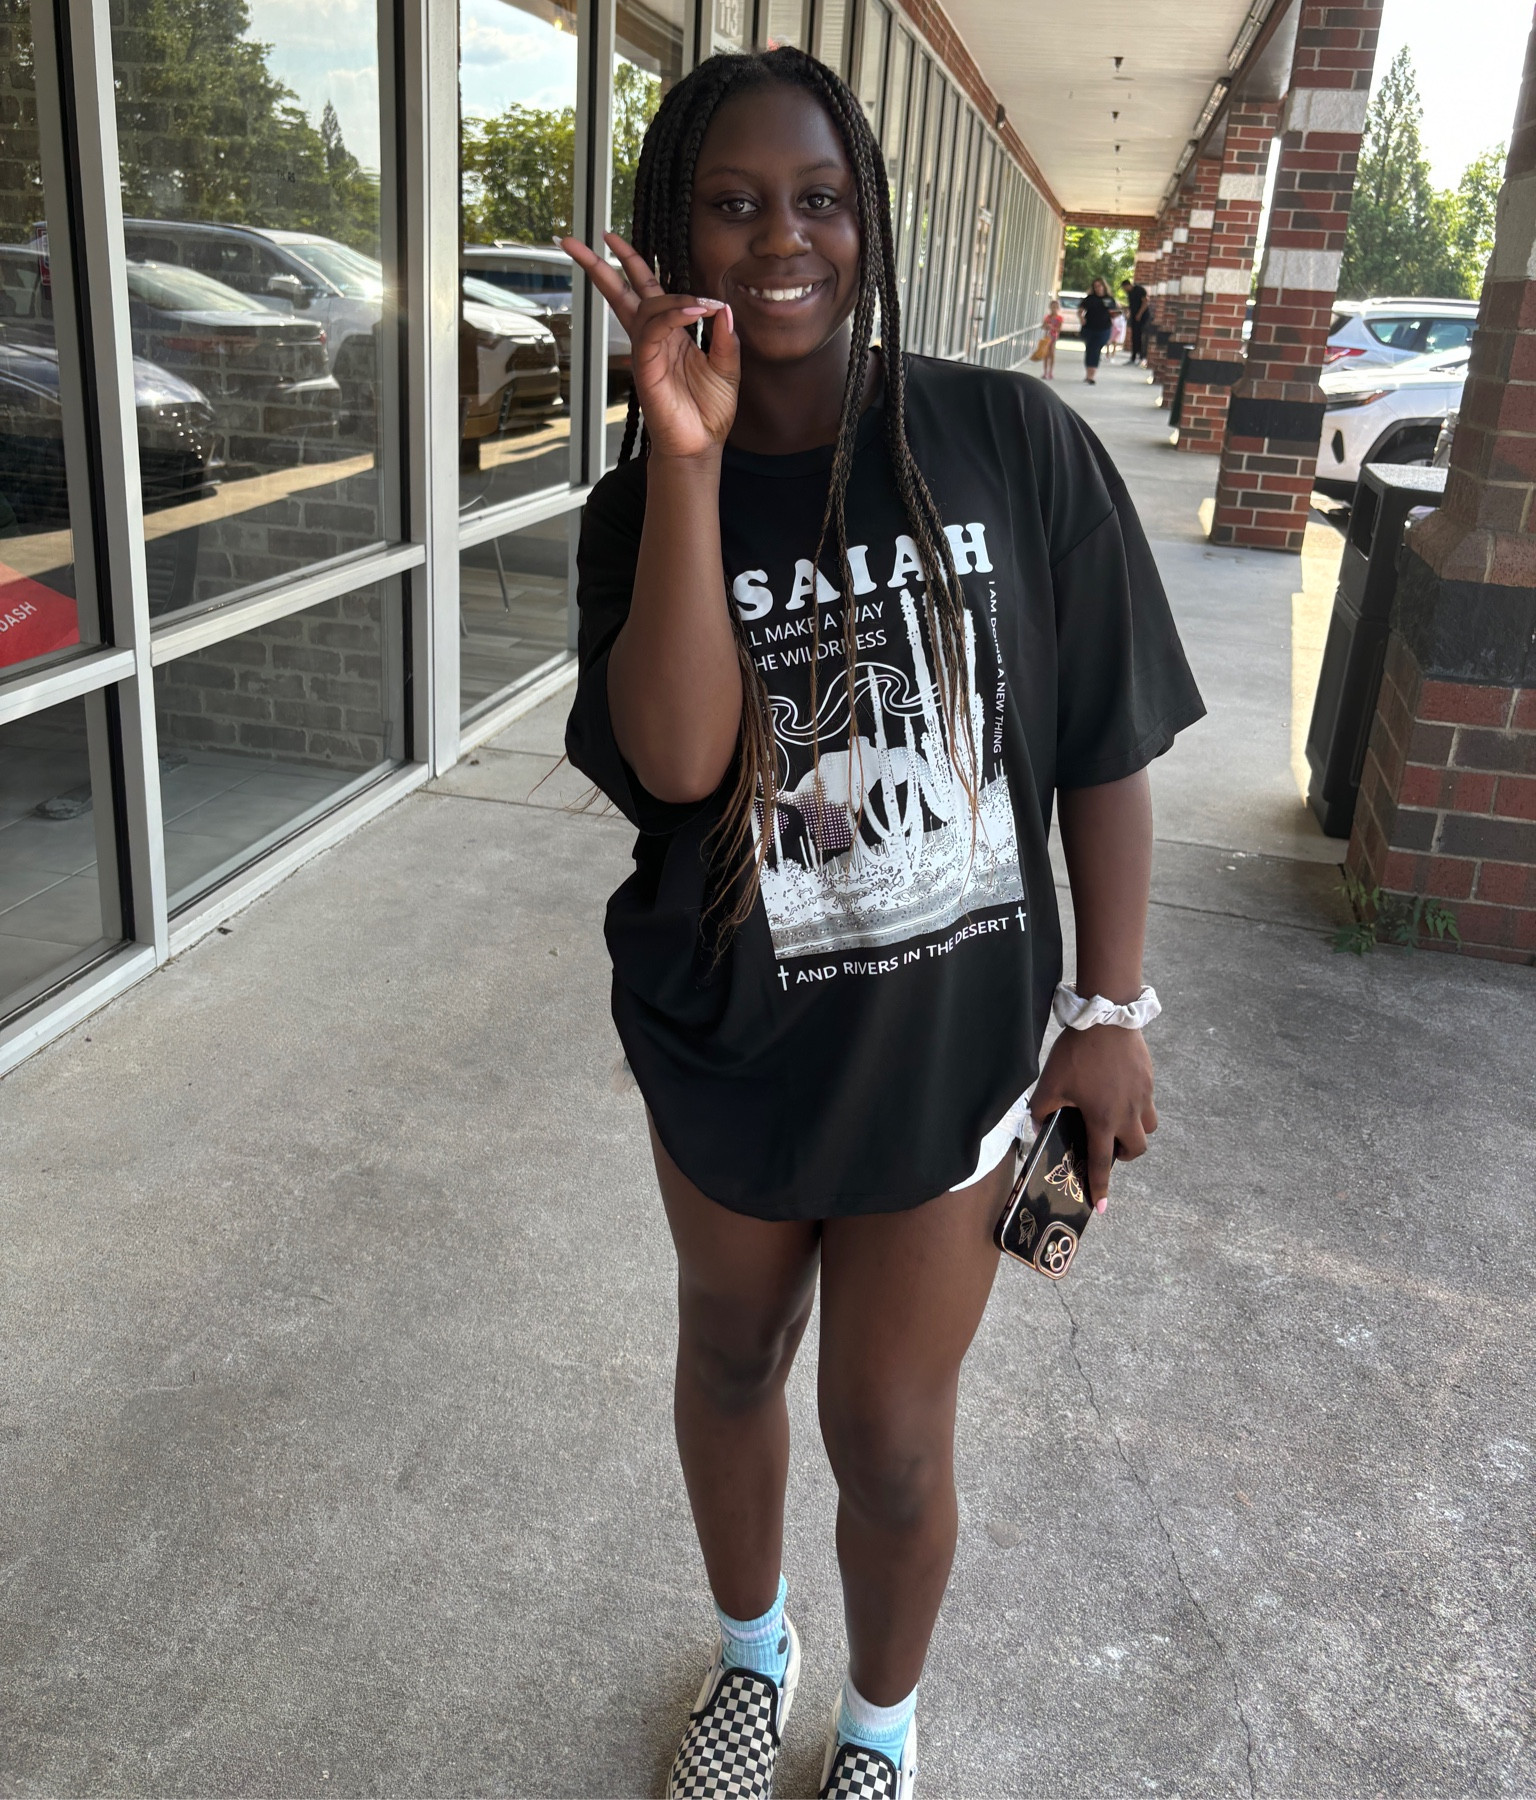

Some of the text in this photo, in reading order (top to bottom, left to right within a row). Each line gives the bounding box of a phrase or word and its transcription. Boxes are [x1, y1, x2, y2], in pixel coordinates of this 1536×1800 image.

[733, 522, 994, 621] SAIAH
[989, 588, 997, 612] AM
[764, 616, 816, 644] MAKE
[823, 612, 838, 631] A
[990, 617, 1003, 664] DOING
[753, 653, 779, 673] HE
[997, 668, 1005, 679] A
[995, 682, 1006, 713] NEW
[993, 715, 1004, 754] THING
[796, 917, 1010, 984] AND RIVERS IN THE DESERT
